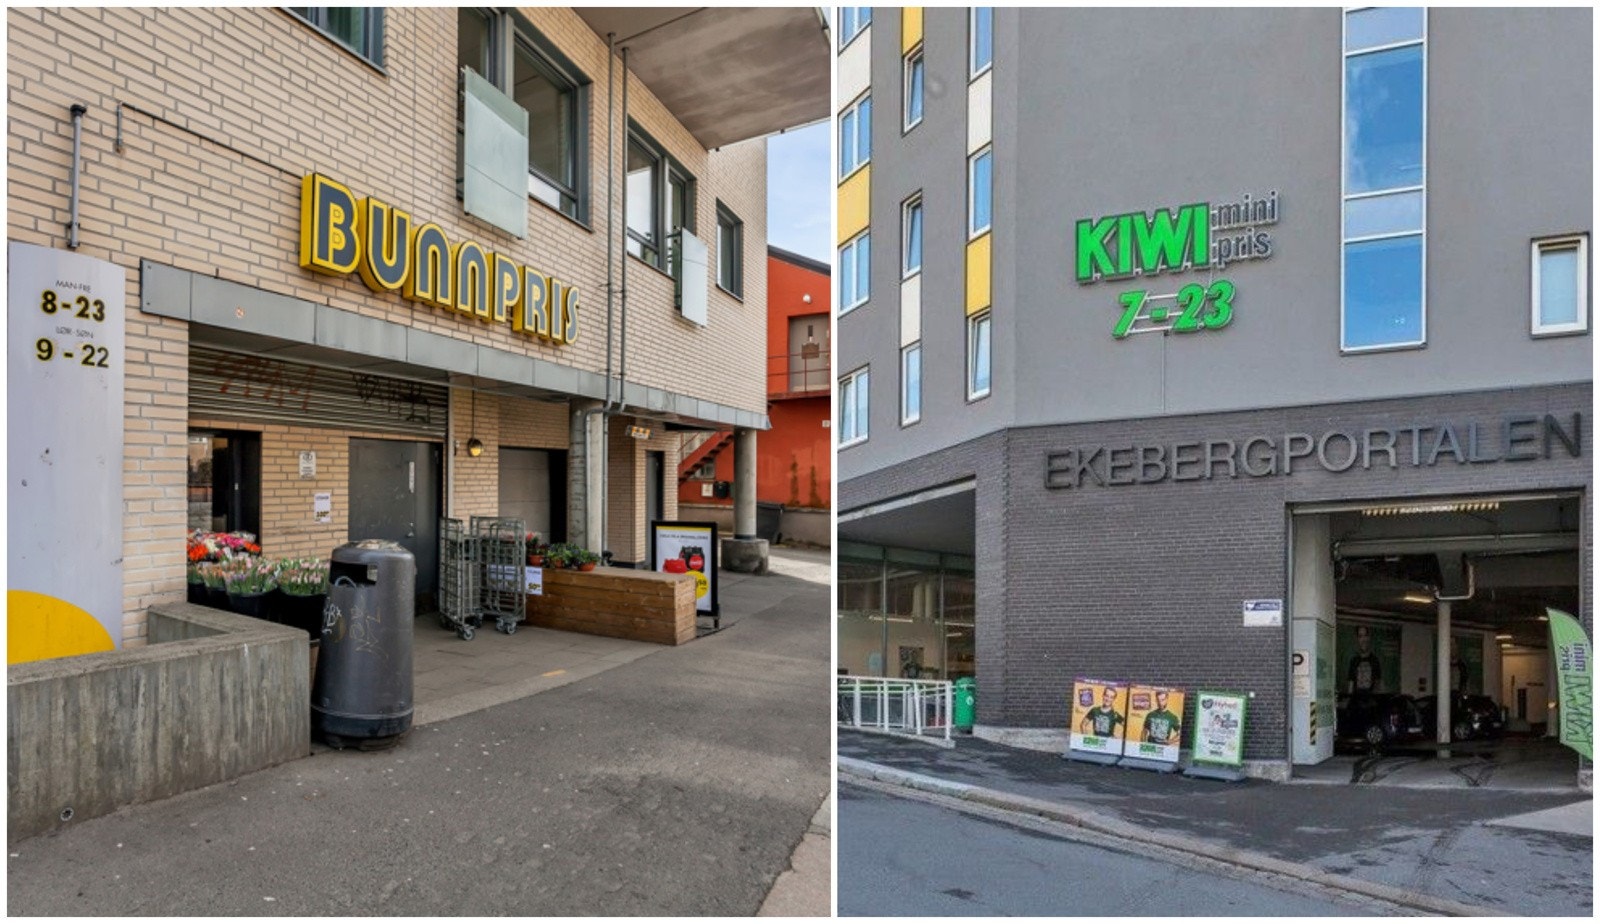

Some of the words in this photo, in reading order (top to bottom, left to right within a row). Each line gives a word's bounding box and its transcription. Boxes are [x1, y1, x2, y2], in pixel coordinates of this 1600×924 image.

[300, 172, 580, 346] BUNNPRIS
[1075, 203, 1211, 284] KIWI
[1215, 190, 1278, 226] mini
[1215, 228, 1271, 268] pris
[1044, 412, 1583, 491] EKEBERGPORTALEN
